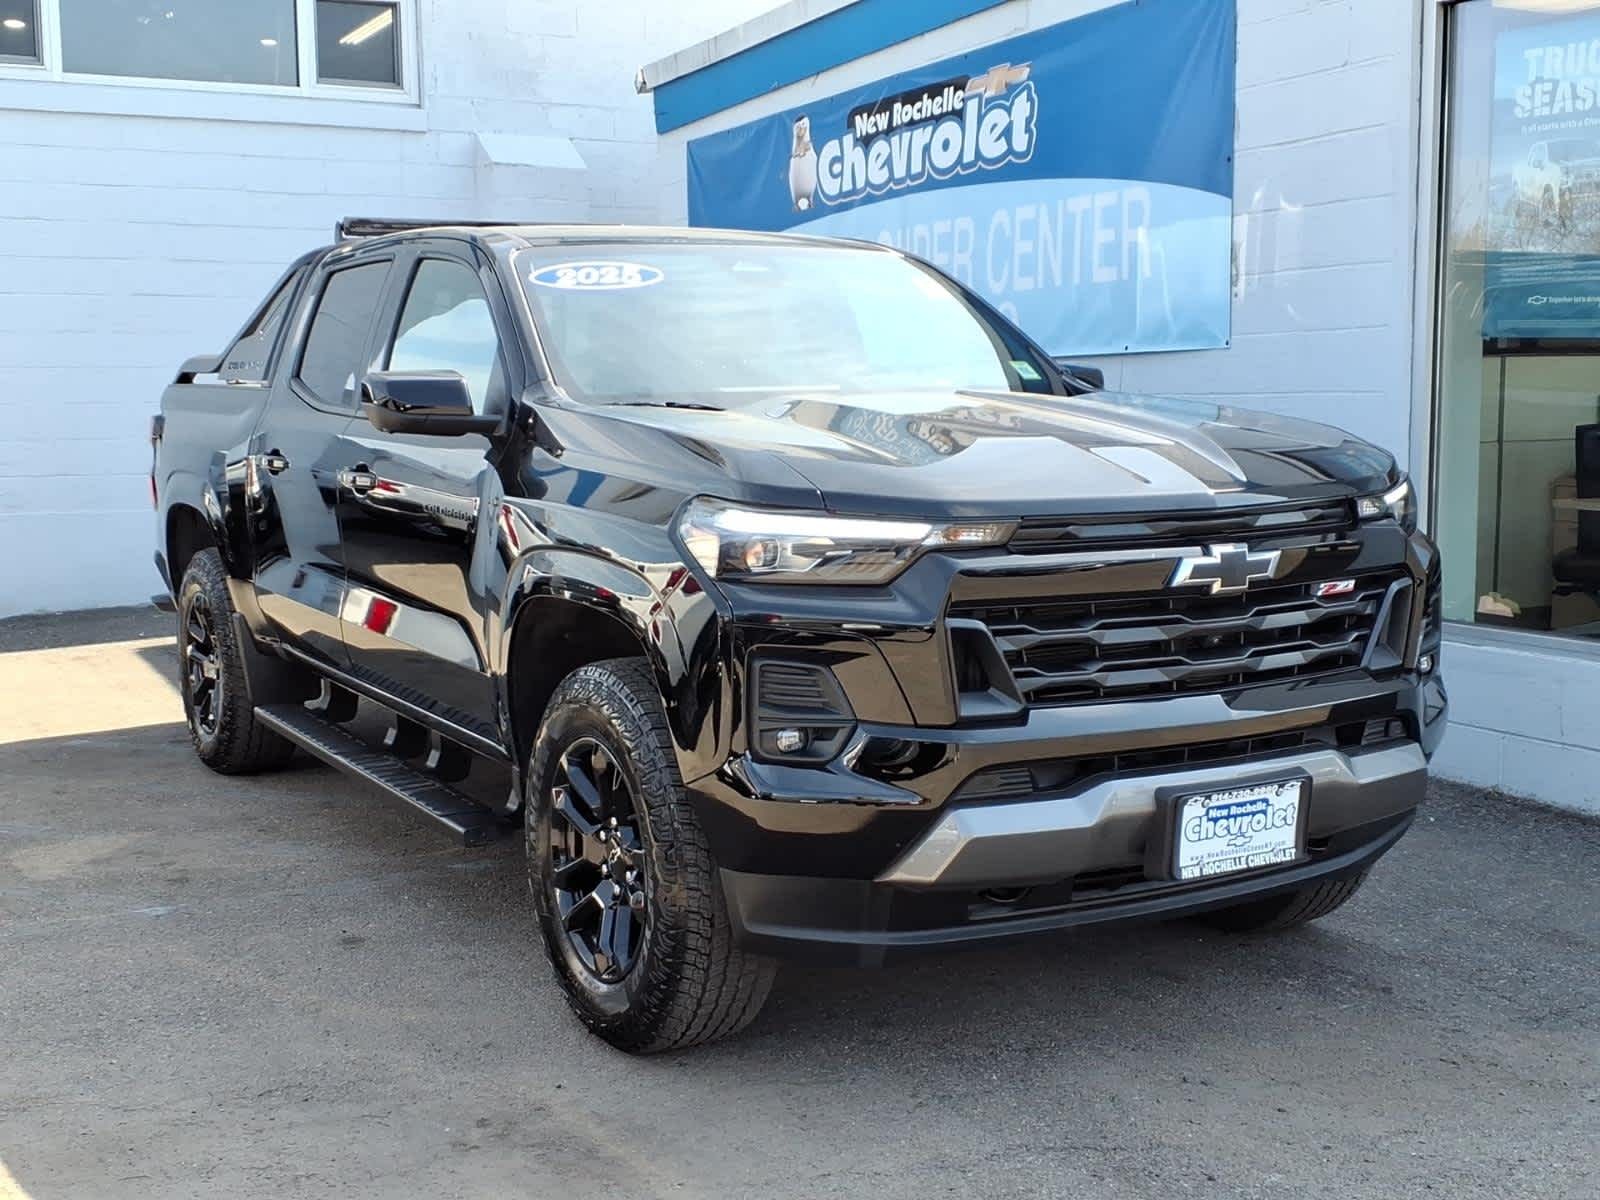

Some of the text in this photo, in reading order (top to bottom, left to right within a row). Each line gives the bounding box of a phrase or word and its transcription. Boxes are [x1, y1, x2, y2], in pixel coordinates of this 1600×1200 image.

[855, 86, 964, 138] New Rochelle
[1513, 78, 1600, 119] SEAS
[818, 92, 1030, 196] Chevrolet
[986, 186, 1151, 295] CENTER
[1185, 802, 1297, 842] Chevrolet
